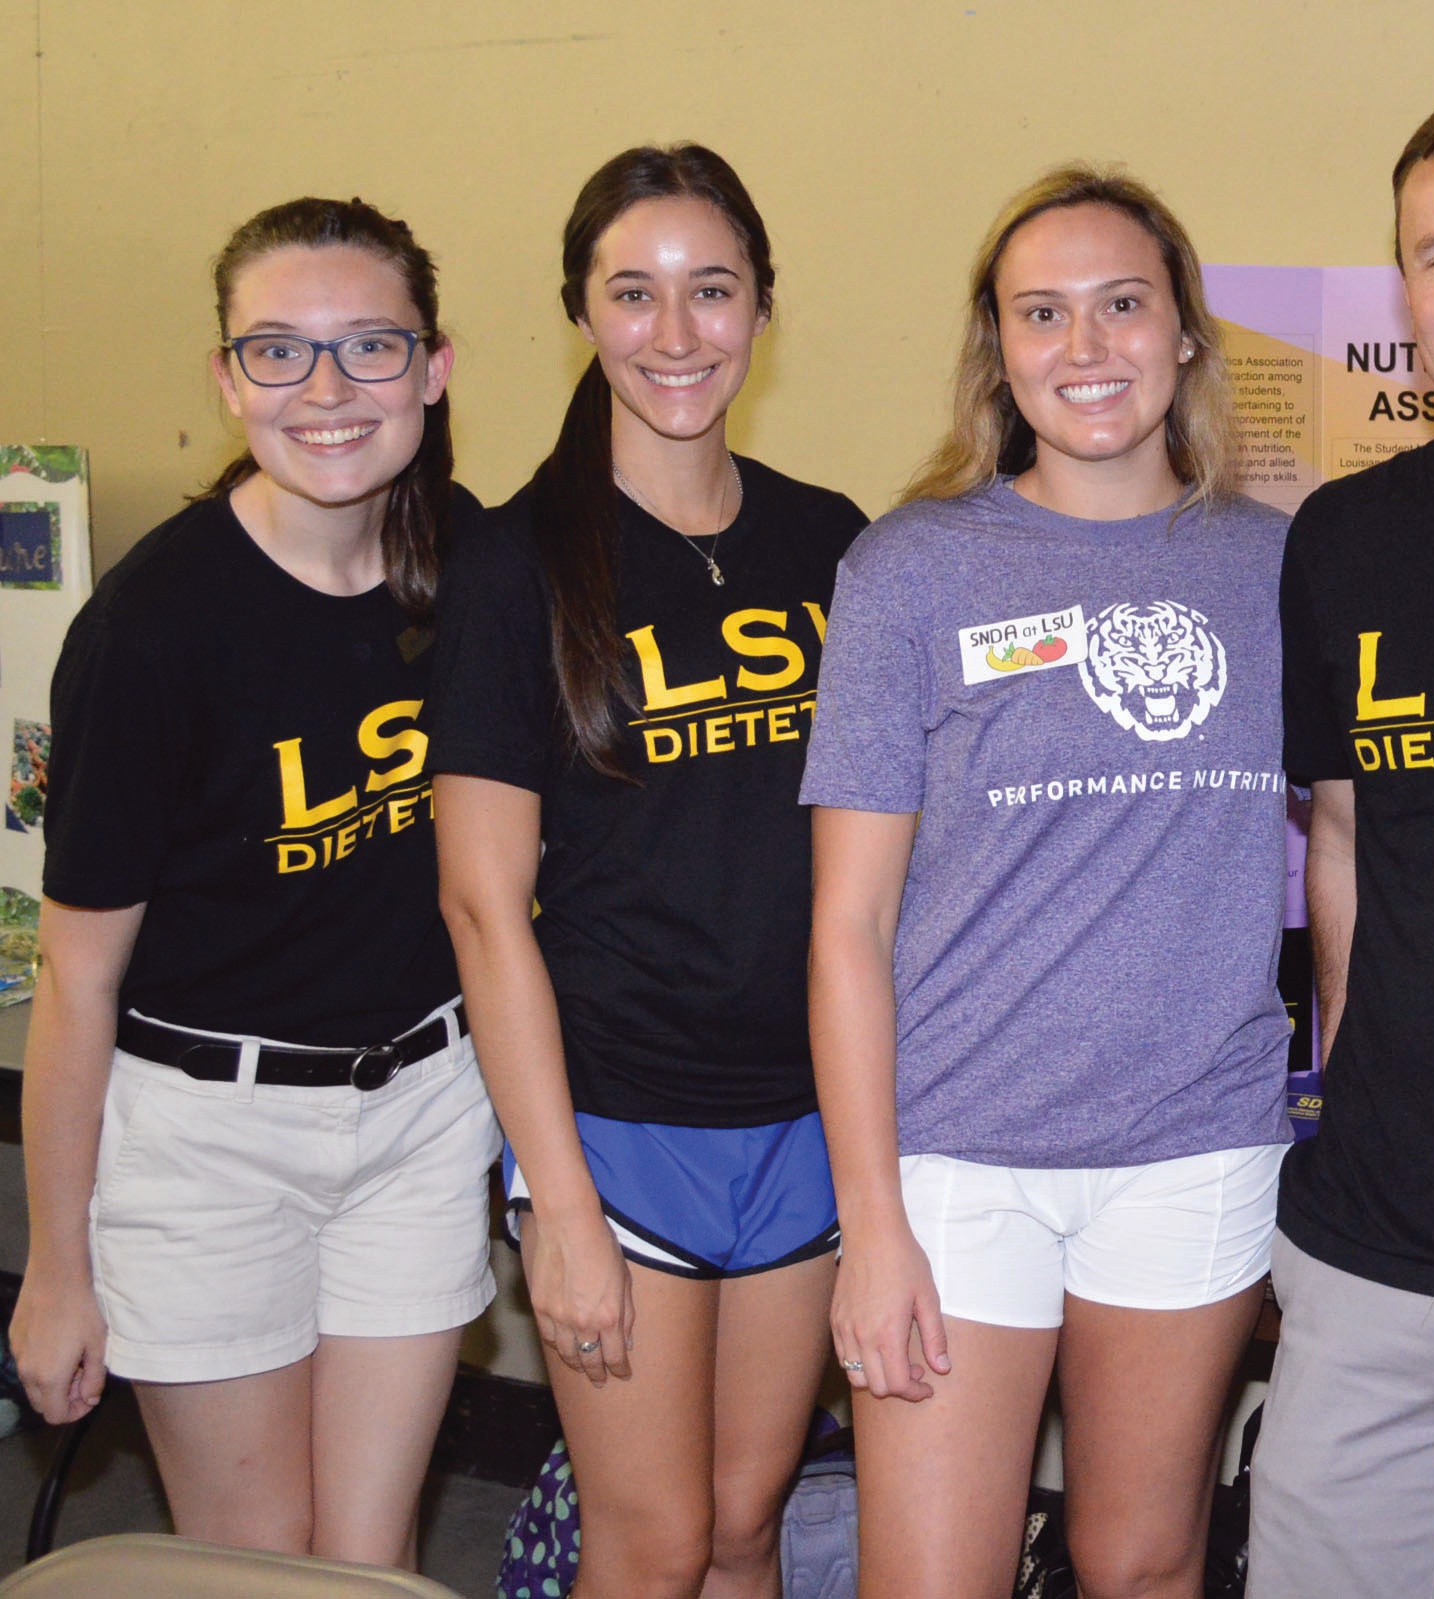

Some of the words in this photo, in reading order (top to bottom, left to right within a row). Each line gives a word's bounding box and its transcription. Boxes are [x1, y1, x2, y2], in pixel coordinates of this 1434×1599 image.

[1246, 356, 1303, 367] Association
[1346, 342, 1418, 373] NUT
[1268, 373, 1302, 383] among
[1285, 401, 1294, 410] to
[1296, 414, 1306, 424] of
[1273, 429, 1282, 439] of
[1285, 429, 1302, 439] the
[1354, 443, 1371, 454] The
[1247, 458, 1266, 468] and
[1269, 458, 1295, 468] allied
[970, 624, 1017, 647] SNDA
[1023, 625, 1037, 637] at
[1042, 612, 1073, 633] LSU
[987, 771, 1182, 807] PERFORMANCE
